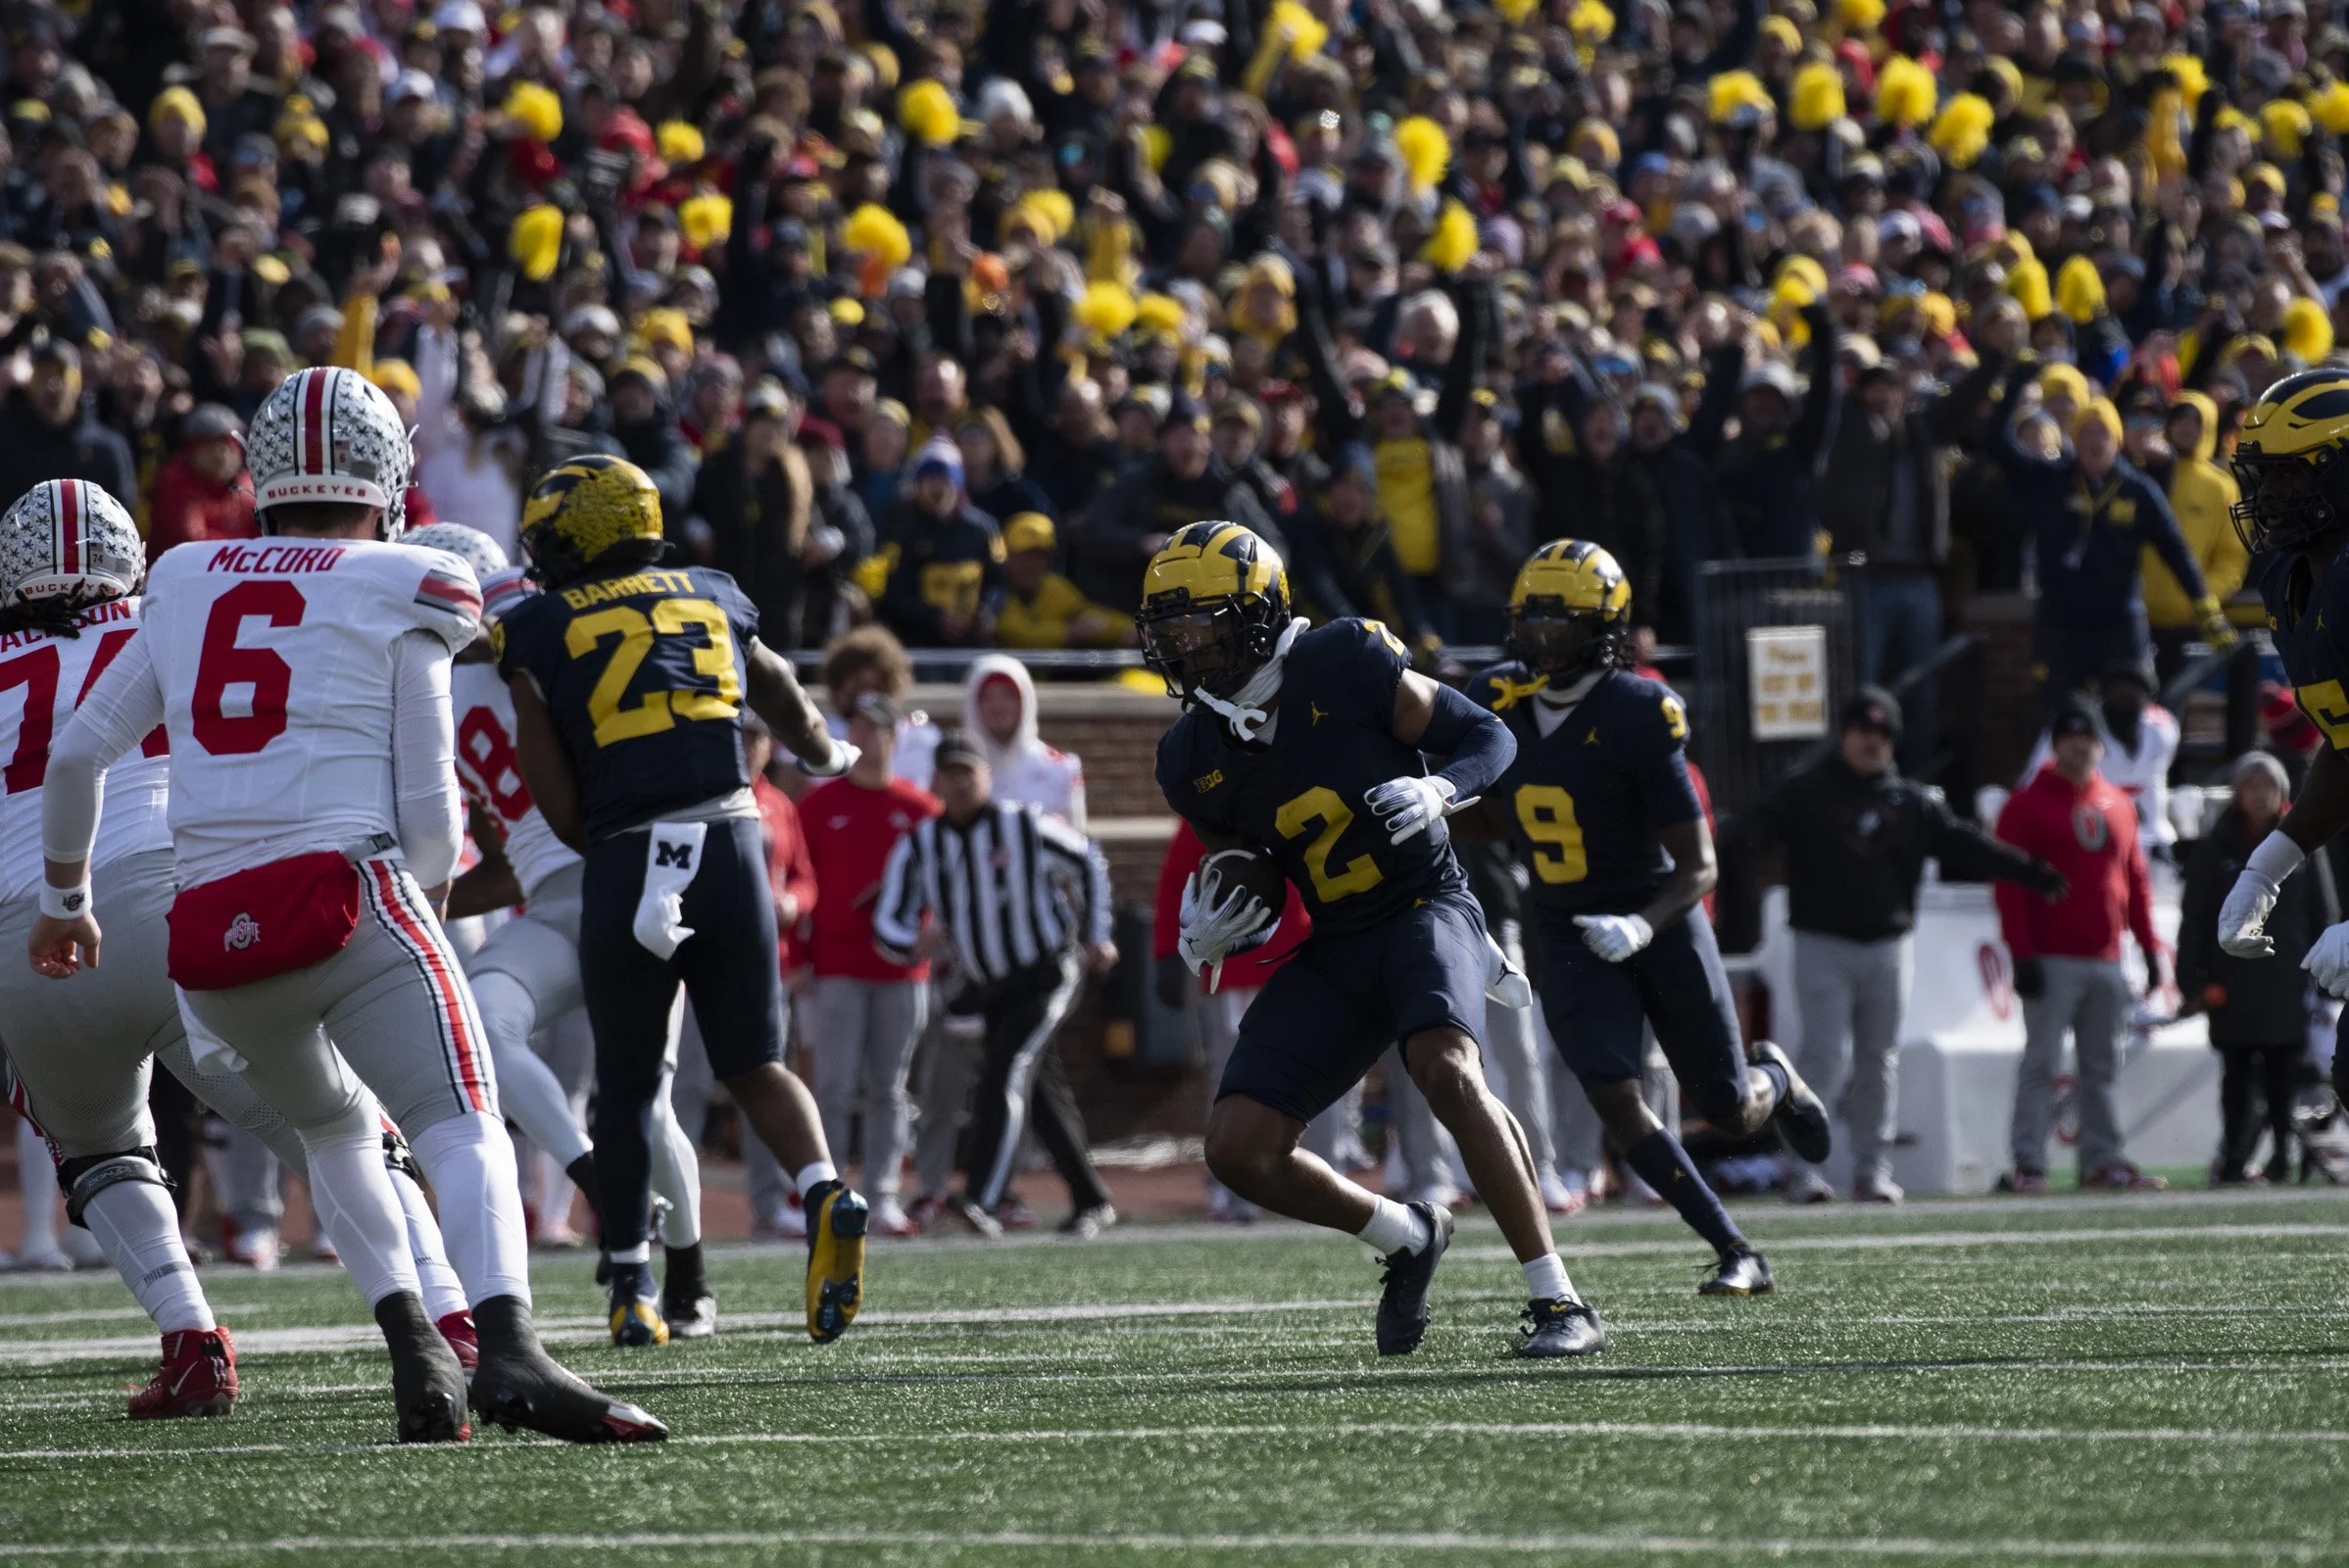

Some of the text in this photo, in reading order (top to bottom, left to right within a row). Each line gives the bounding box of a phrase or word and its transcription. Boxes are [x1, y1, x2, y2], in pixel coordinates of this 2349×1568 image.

[268, 484, 367, 499] BUCKEYES
[24, 582, 118, 595] BUCKYS
[562, 571, 696, 611] BARRETT
[191, 580, 307, 756] 6
[564, 598, 742, 749] 23
[1661, 696, 1686, 738] 9
[656, 840, 694, 869] M
[1275, 785, 1385, 903] 2
[1515, 783, 1589, 884] 9
